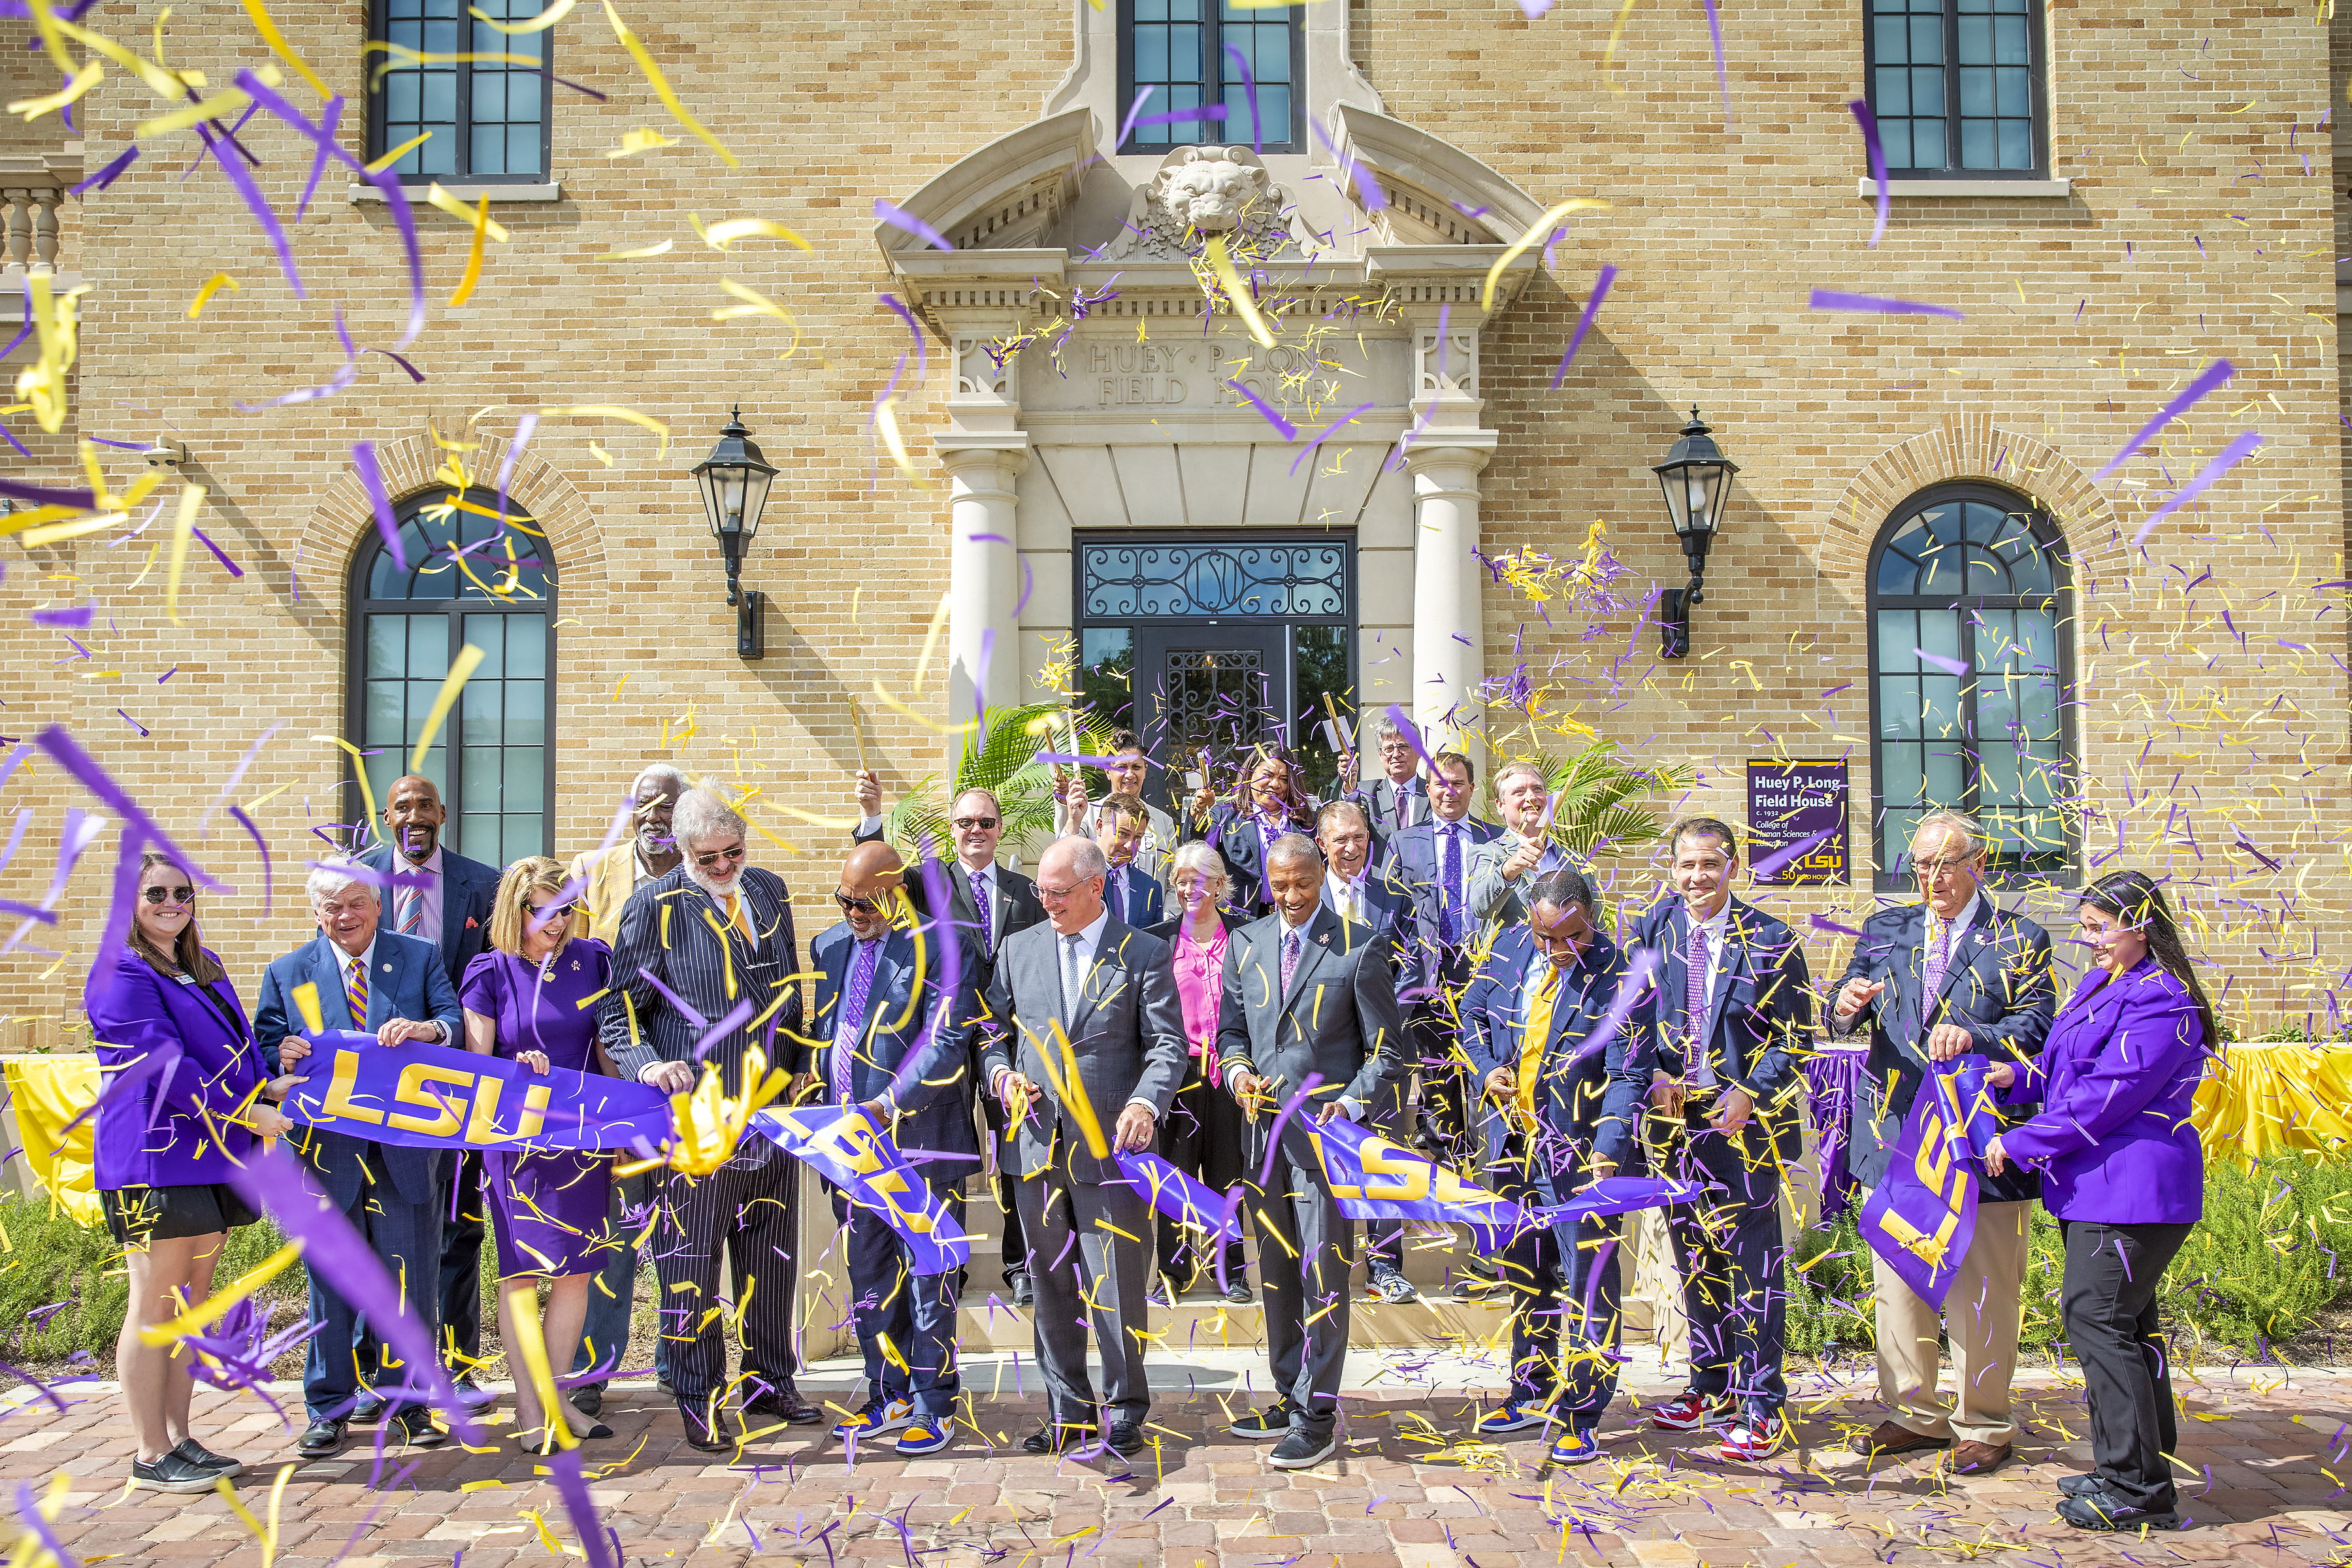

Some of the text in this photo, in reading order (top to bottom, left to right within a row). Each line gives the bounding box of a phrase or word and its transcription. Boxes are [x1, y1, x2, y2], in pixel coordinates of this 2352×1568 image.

[1089, 346, 1183, 372] HUEY
[1247, 346, 1338, 372] LONG
[1099, 376, 1326, 404] FIELD HOUSE
[1755, 776, 1840, 791] Huey P. Long
[1756, 794, 1833, 807] Field House
[1756, 821, 1789, 830] College of
[1805, 855, 1841, 868] LSU
[1782, 870, 1796, 880] 50
[322, 1049, 551, 1145] LSU
